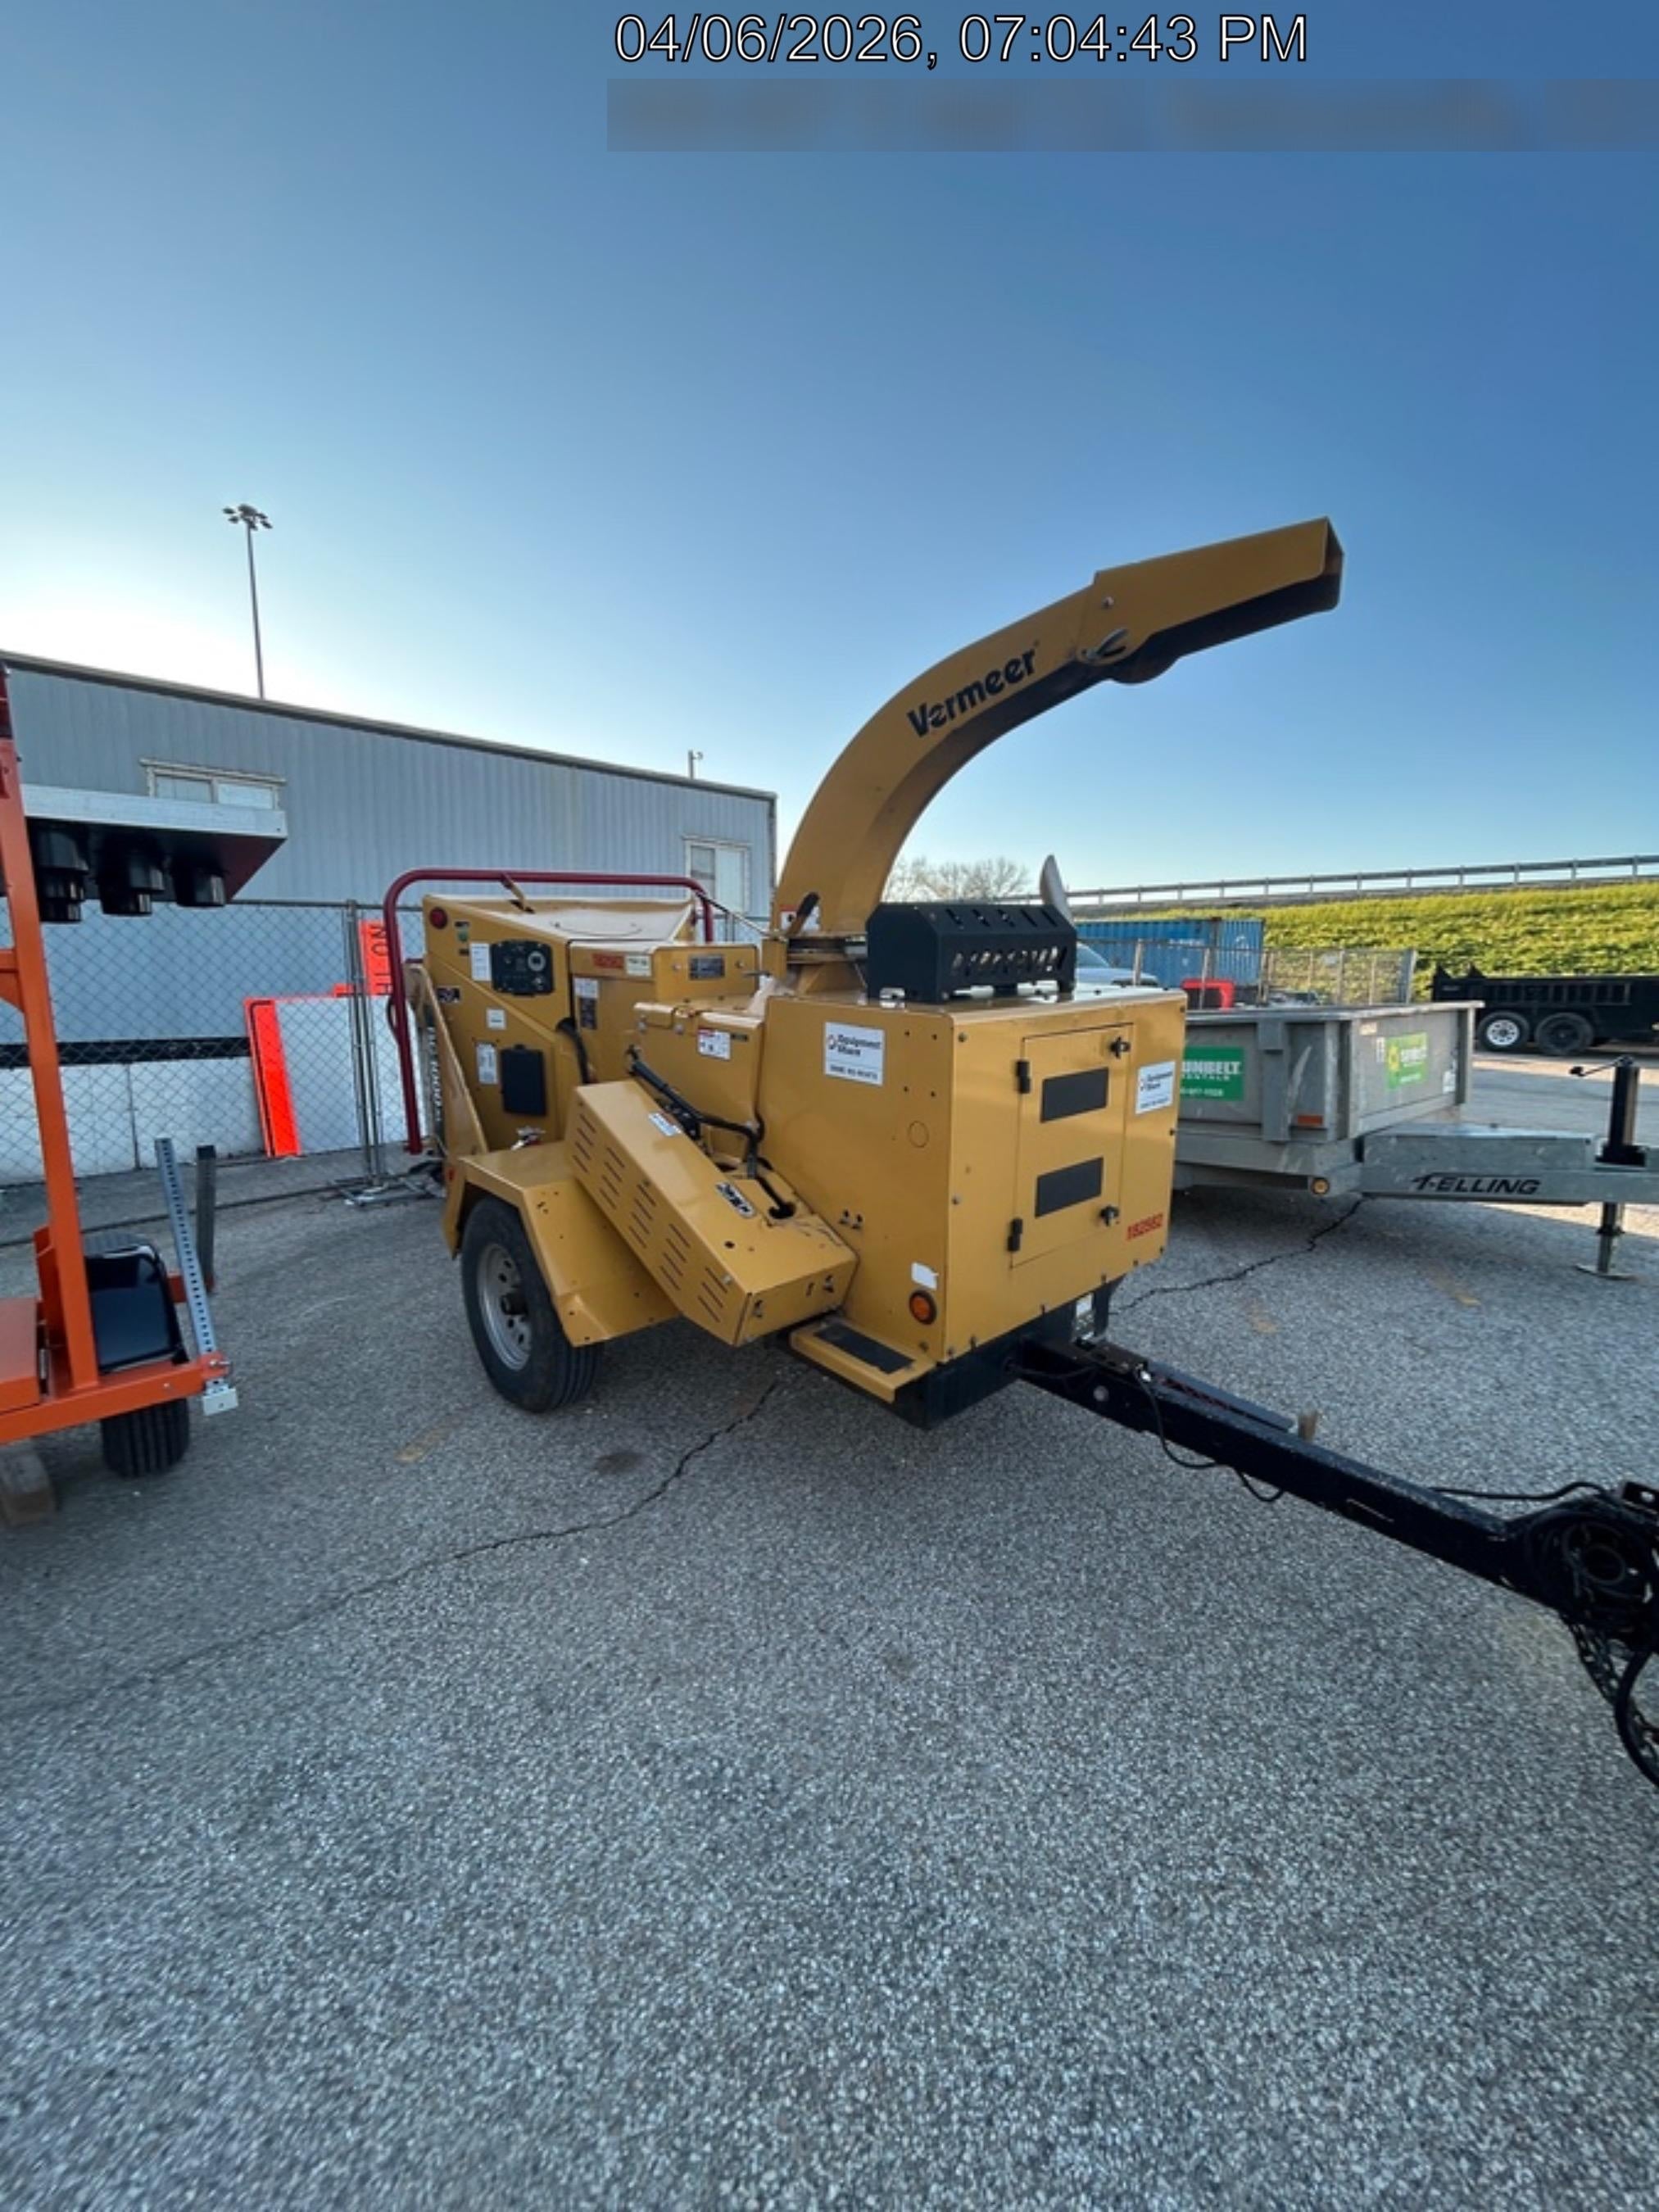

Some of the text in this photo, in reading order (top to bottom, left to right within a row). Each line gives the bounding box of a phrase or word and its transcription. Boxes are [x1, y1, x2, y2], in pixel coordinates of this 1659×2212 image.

[907, 647, 1038, 737] Vermeer
[1182, 1061, 1241, 1075] UNBELT
[1412, 1172, 1541, 1194] FELLING
